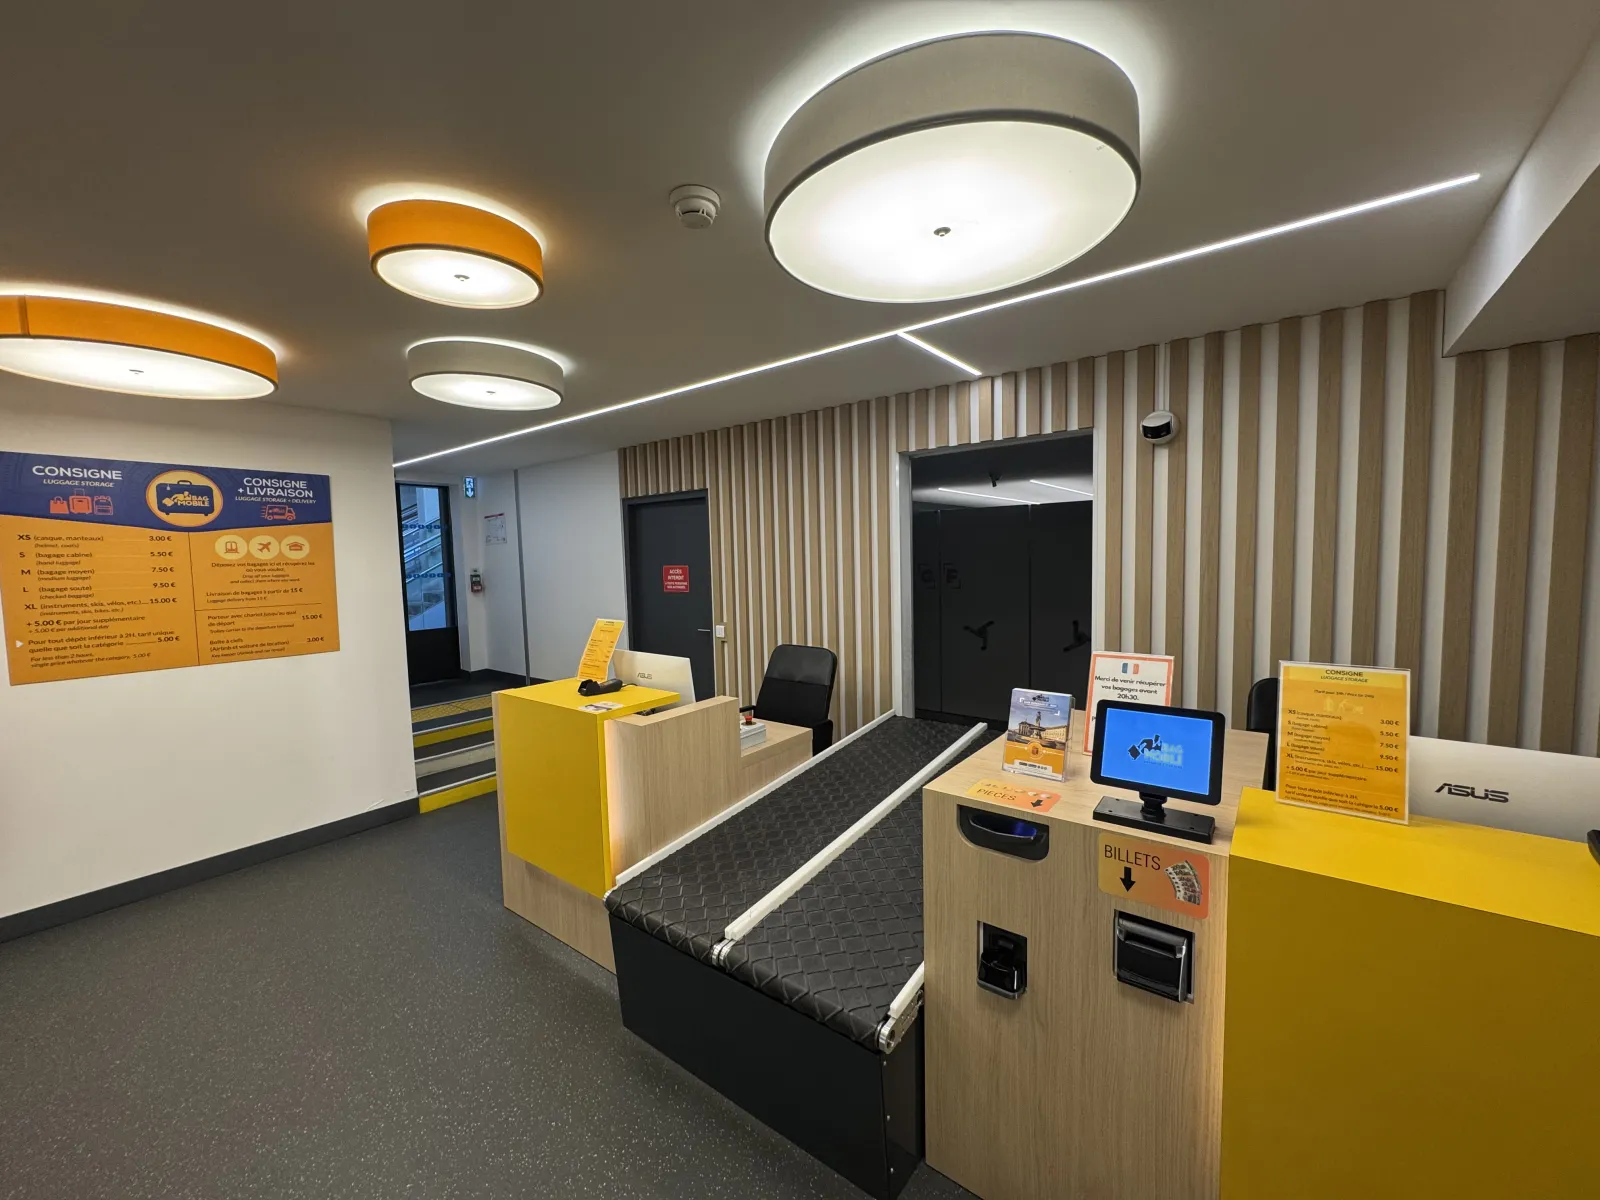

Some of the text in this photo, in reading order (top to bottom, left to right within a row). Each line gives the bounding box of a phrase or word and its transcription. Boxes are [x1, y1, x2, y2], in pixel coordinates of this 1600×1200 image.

[32, 465, 122, 480] CONSIGNE
[81, 480, 115, 488] STORAGE
[243, 477, 307, 489] CONSIGNE
[247, 486, 313, 498] LIVRAISON
[177, 499, 210, 507] MOBILE
[1325, 669, 1364, 677] CONSIGNE
[1112, 685, 1138, 693] bagages
[1116, 693, 1139, 701] 20h30.
[1375, 765, 1394, 773] 15.00
[1434, 782, 1509, 804] ASUS
[1379, 804, 1394, 812] 5.00
[1104, 844, 1161, 871] BILLETS
